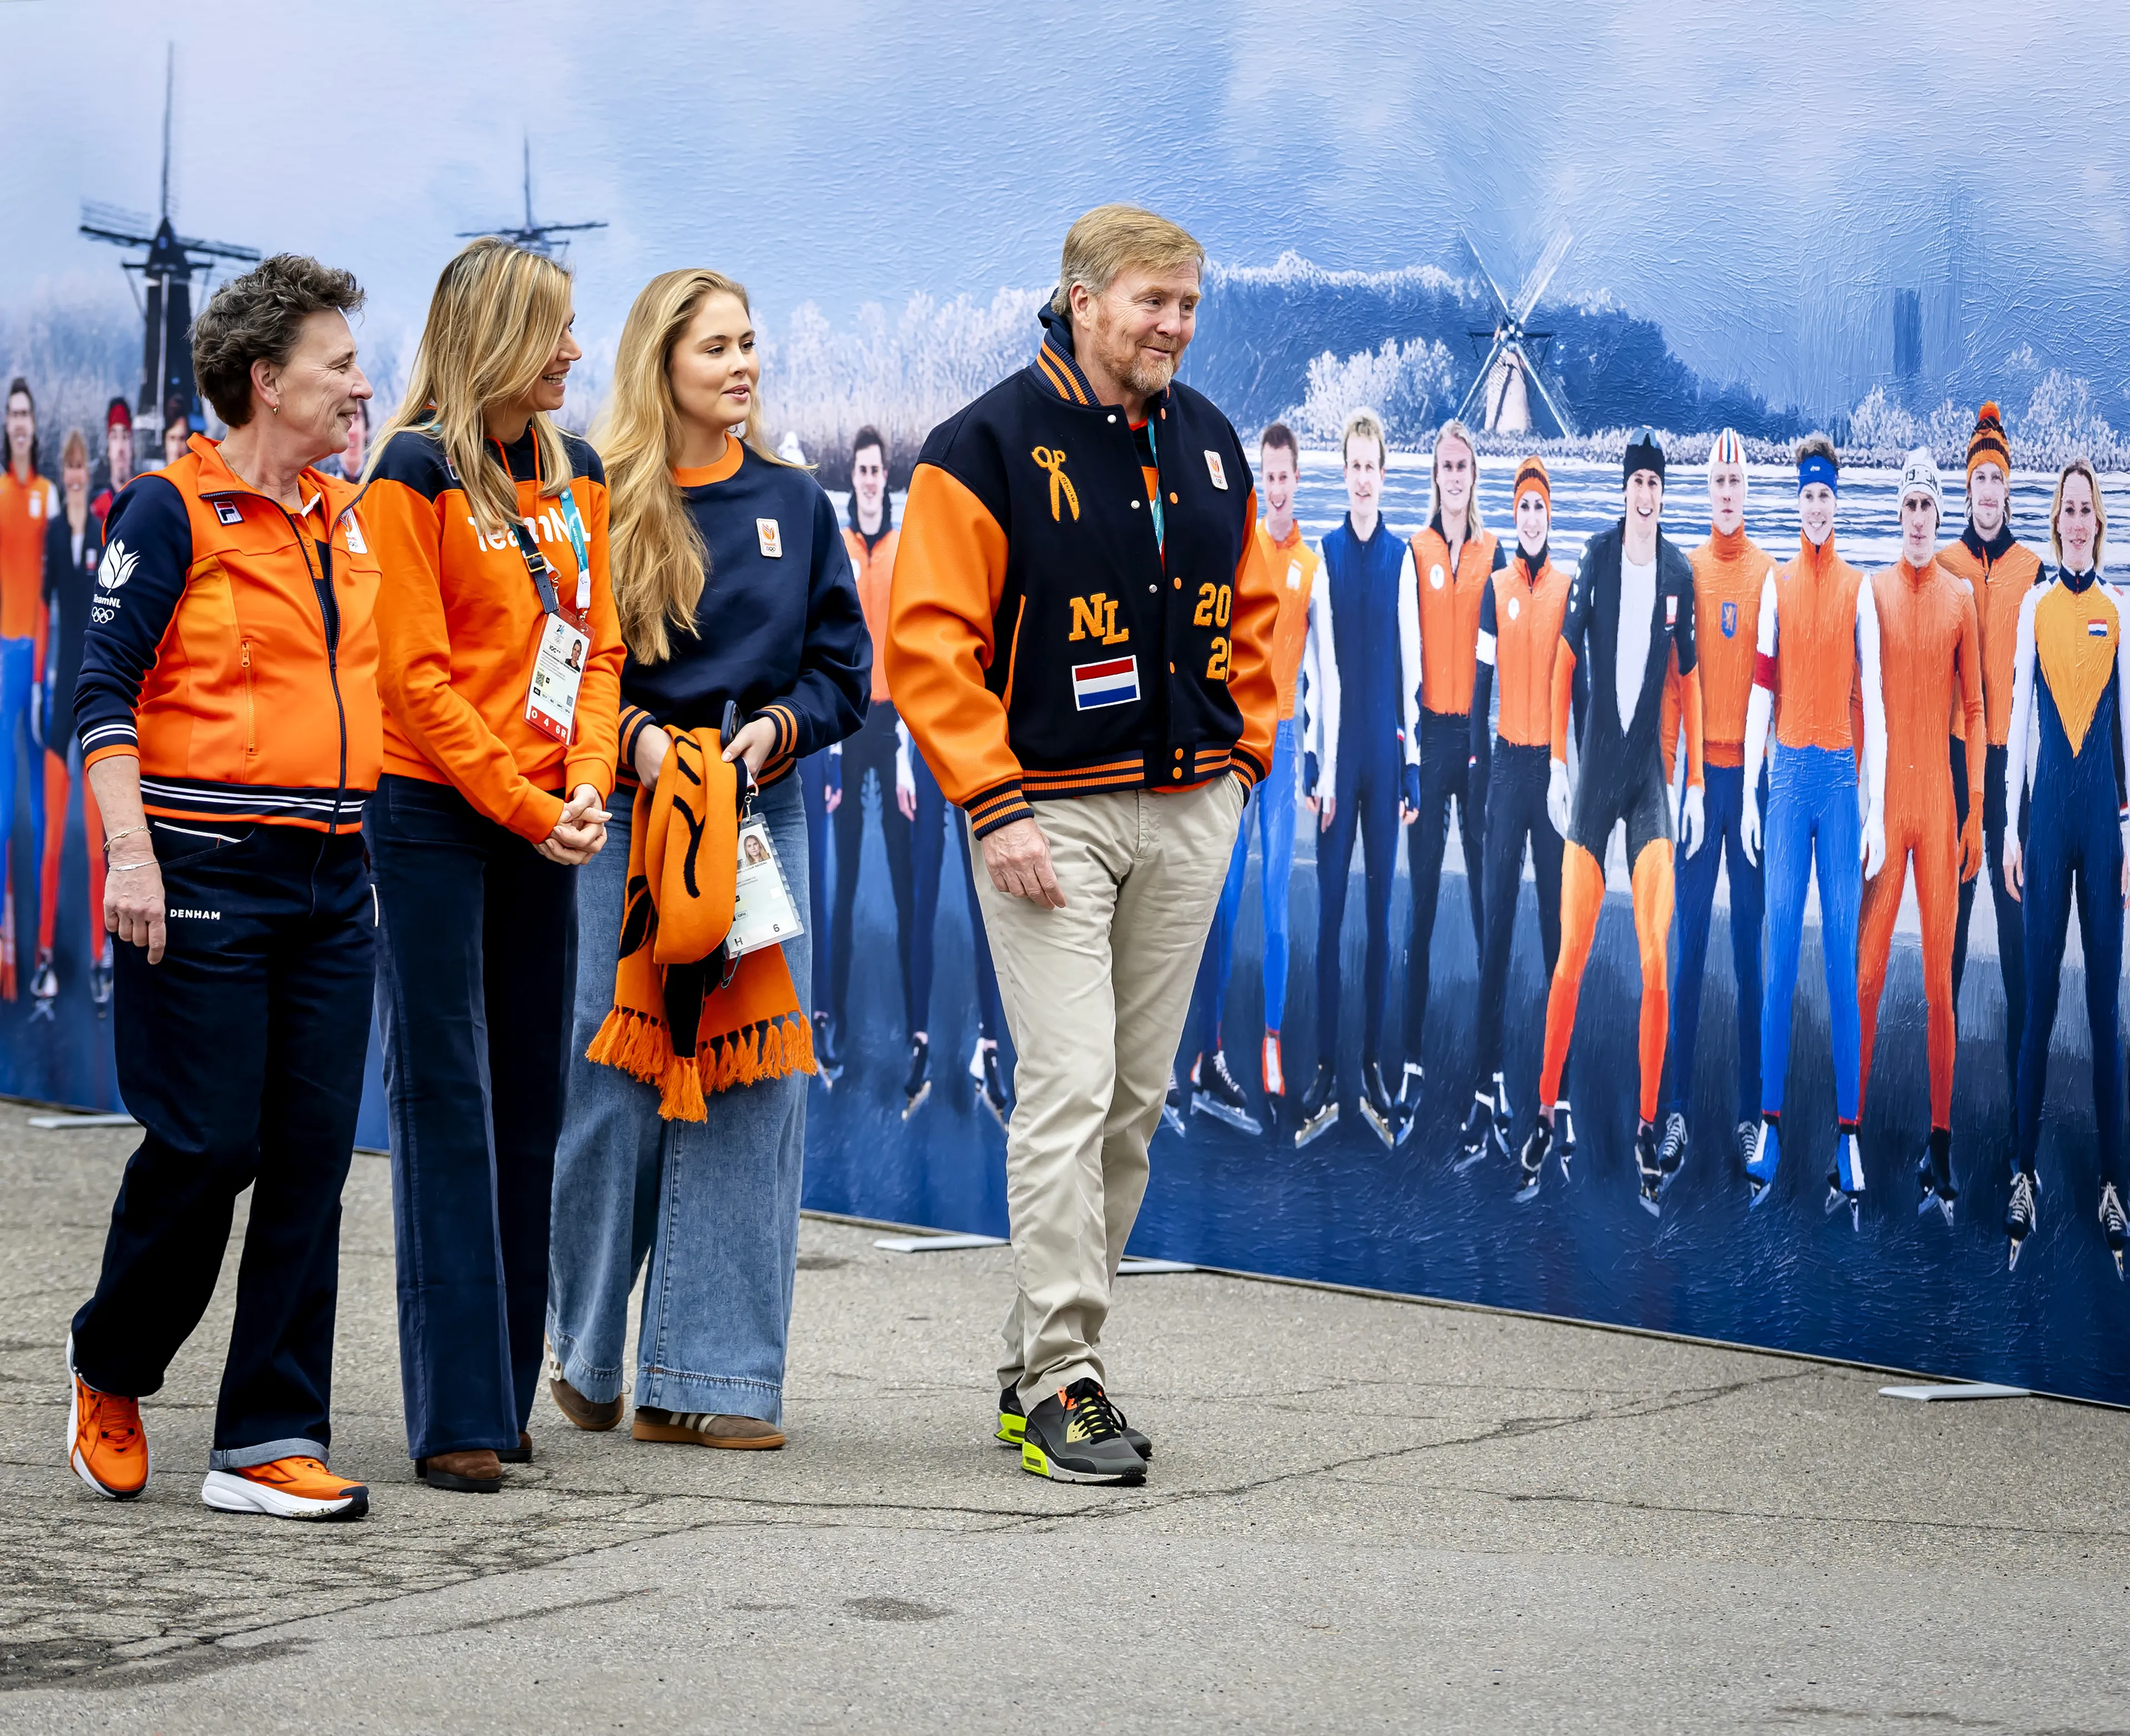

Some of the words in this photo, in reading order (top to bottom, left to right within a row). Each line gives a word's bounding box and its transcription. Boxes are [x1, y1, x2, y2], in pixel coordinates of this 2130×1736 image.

[1062, 478, 1075, 502] DENHAM
[93, 593, 121, 608] TeamNL
[1193, 582, 1231, 628] 20
[1068, 592, 1129, 645] NL
[544, 718, 549, 727] 4
[170, 908, 221, 920] DENHAM
[734, 937, 743, 946] H
[773, 924, 780, 932] 6
